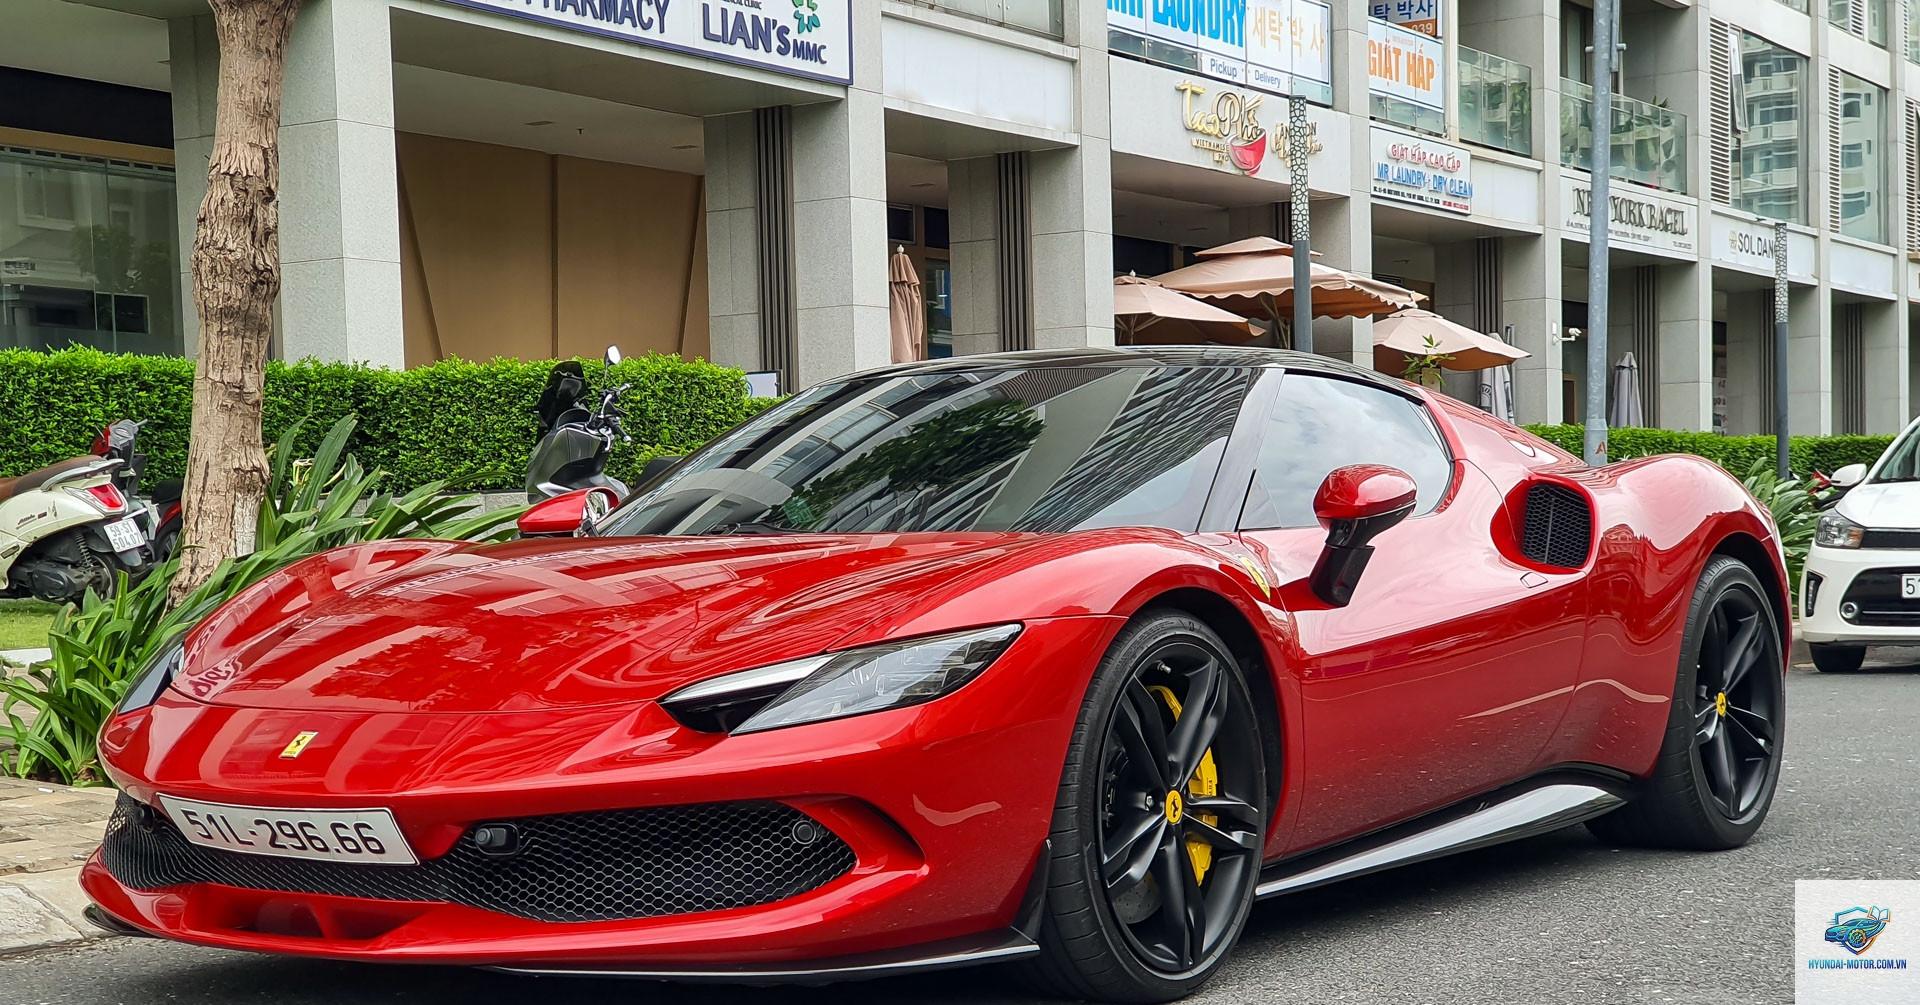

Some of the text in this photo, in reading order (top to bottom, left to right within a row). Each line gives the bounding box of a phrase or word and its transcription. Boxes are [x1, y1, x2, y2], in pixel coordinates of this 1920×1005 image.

[525, 0, 672, 34] RMACY
[792, 38, 827, 64] MMC
[1210, 58, 1238, 79] Pickup
[1254, 69, 1281, 88] Delivery
[1377, 162, 1389, 180] MR
[1391, 165, 1426, 188] LAUNDRY
[1432, 174, 1447, 193] DRY
[1449, 178, 1473, 199] CLEAN
[1573, 187, 1591, 217] NE
[1609, 195, 1646, 228] YORK
[1646, 203, 1688, 236] BAGEL
[1757, 237, 1776, 260] DAN
[1906, 577, 1920, 595] 5
[180, 808, 386, 855] 51L-296.66
